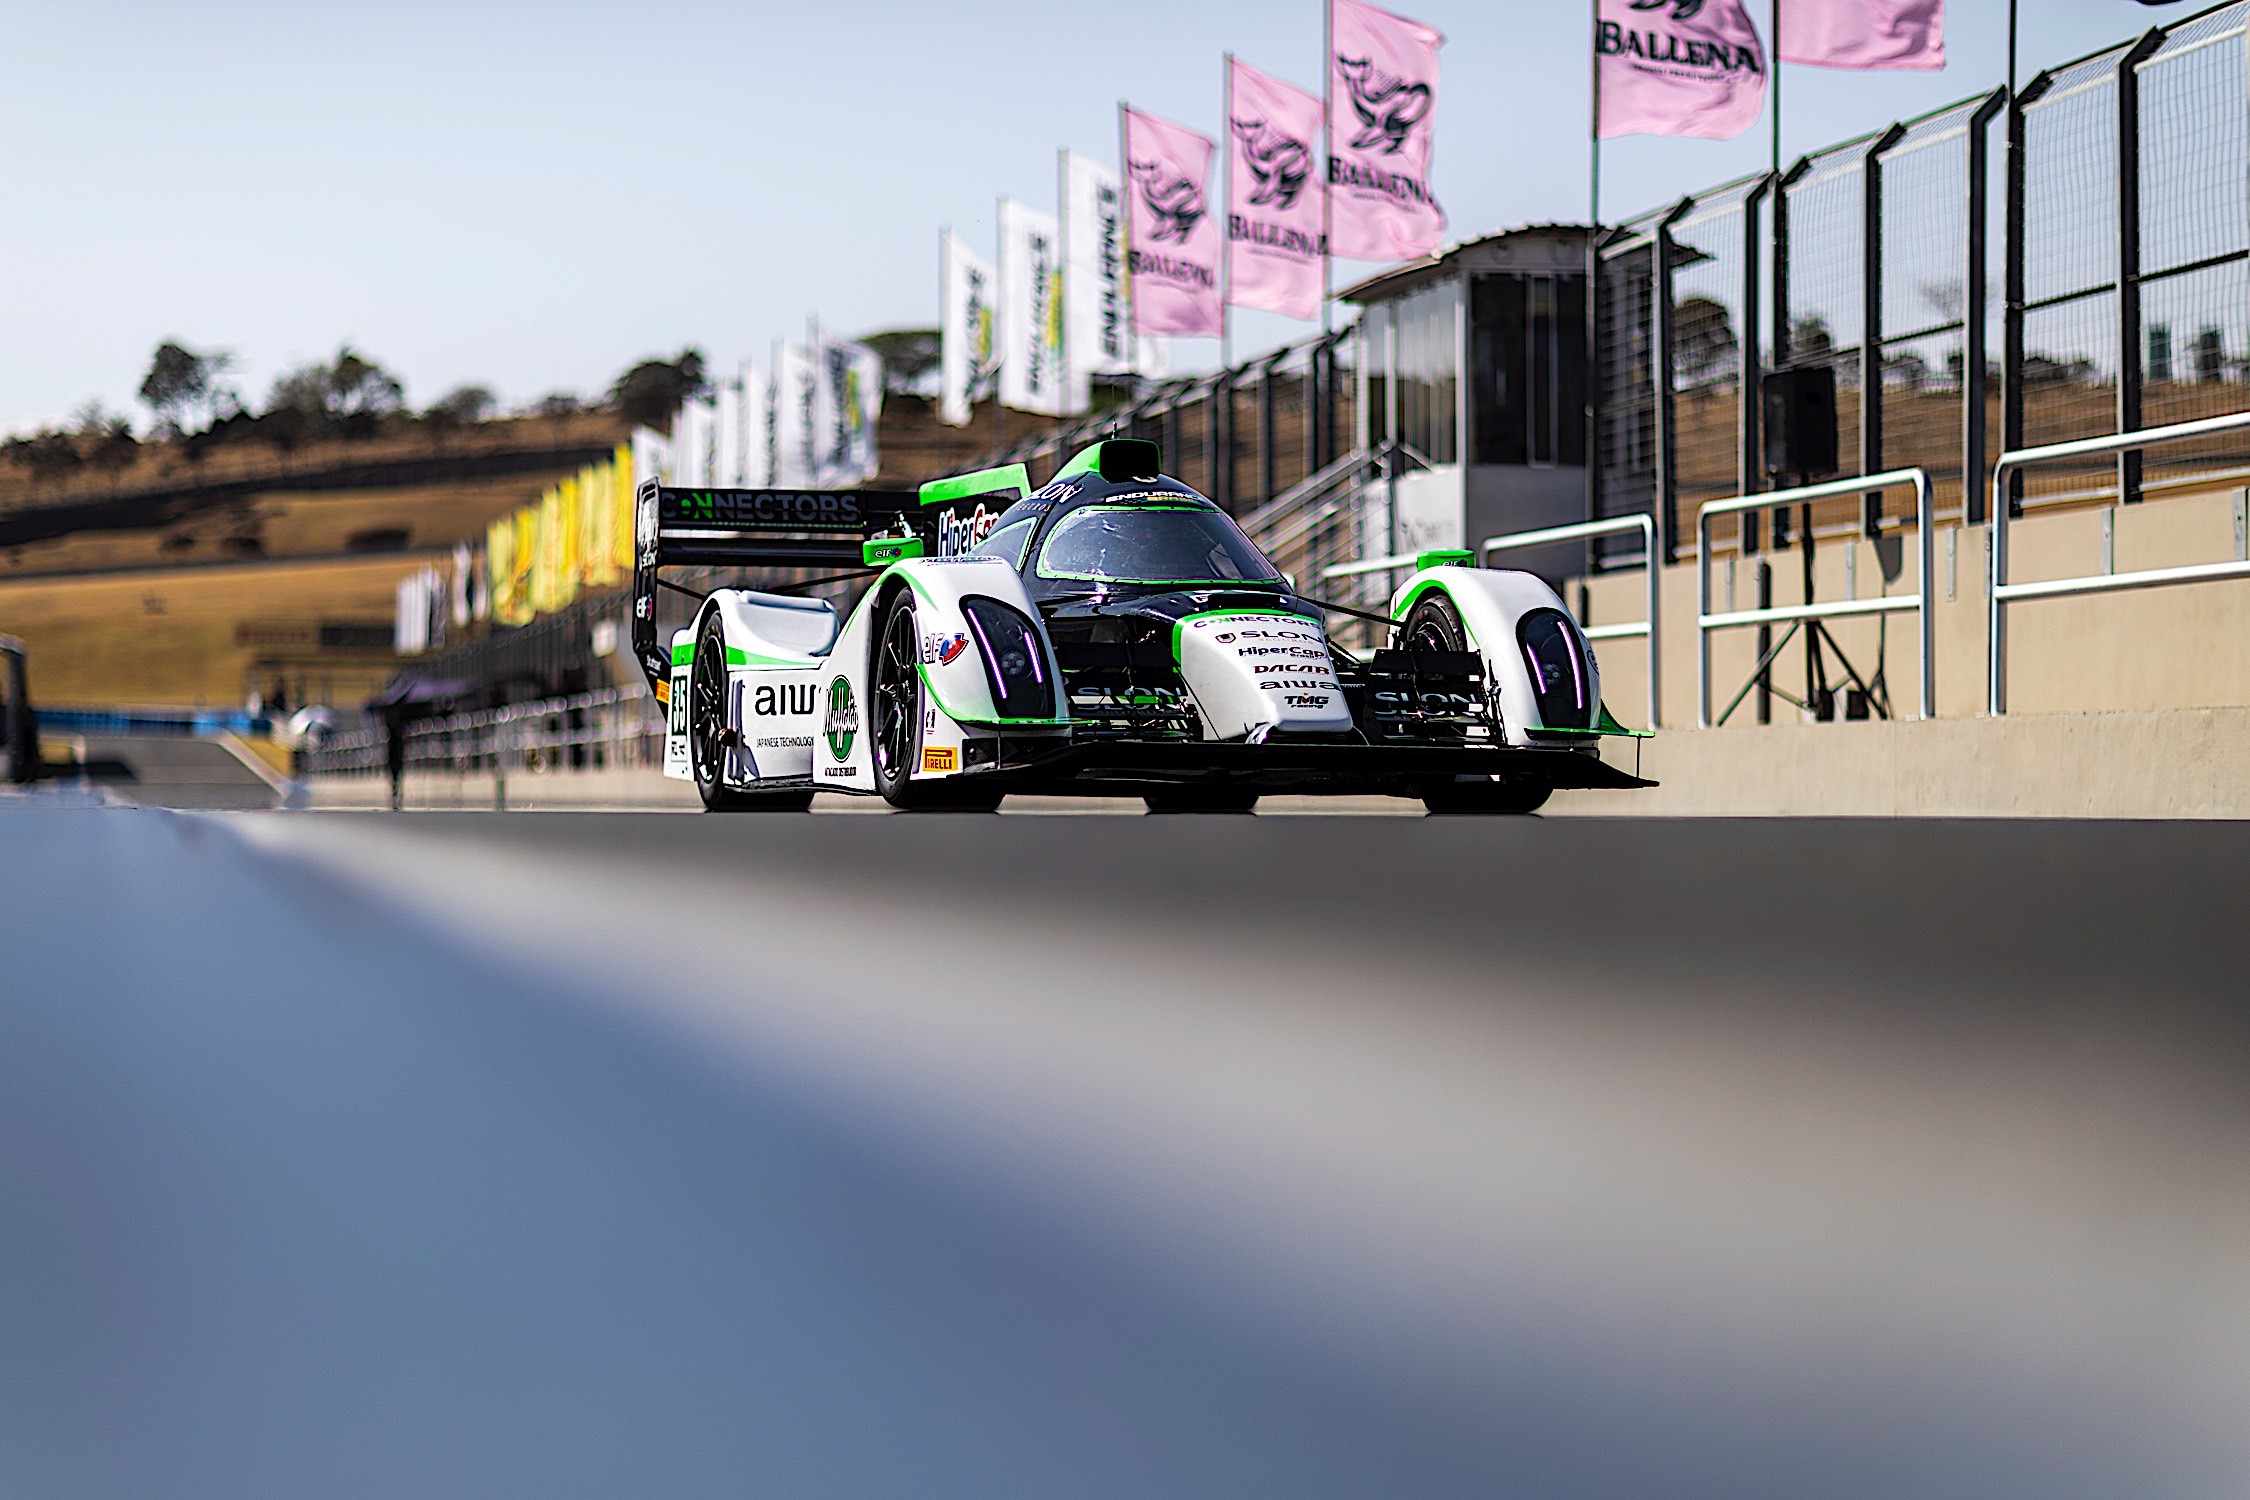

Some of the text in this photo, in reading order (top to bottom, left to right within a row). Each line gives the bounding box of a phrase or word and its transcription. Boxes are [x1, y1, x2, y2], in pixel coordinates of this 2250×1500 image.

[1596, 19, 1763, 75] BALLENA
[1024, 483, 1085, 503] LON
[1106, 491, 1205, 503] ENDURANC
[661, 492, 861, 522] CONNECTORS
[875, 549, 892, 558] elf
[1193, 616, 1322, 630] CONNECTORS
[1240, 631, 1324, 644] SLON
[922, 633, 945, 664] elf
[1238, 647, 1326, 659] HiperCap
[1254, 664, 1330, 675] DACAR
[1260, 681, 1342, 691] aiwa
[673, 680, 686, 733] 35
[755, 684, 821, 716] aiw
[1284, 696, 1329, 705] TMG
[756, 737, 779, 748] JAPANESE
[924, 749, 953, 769] PIRELLI
